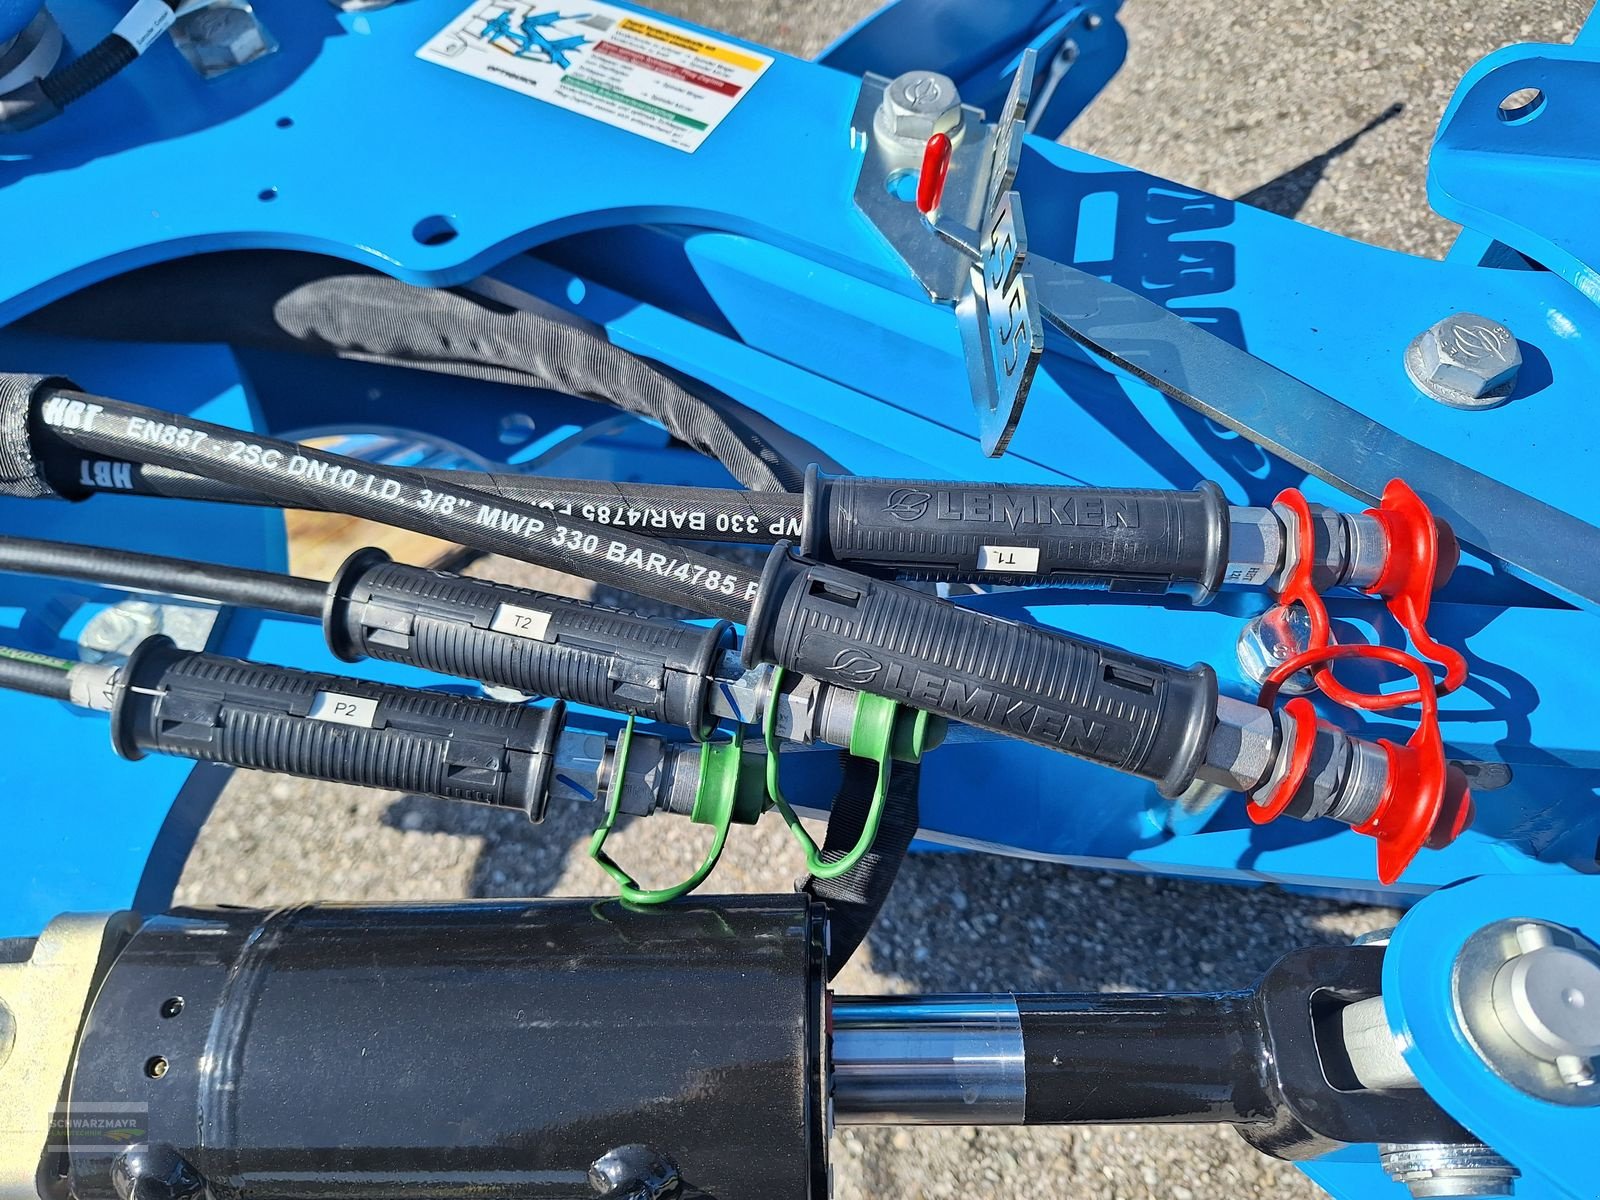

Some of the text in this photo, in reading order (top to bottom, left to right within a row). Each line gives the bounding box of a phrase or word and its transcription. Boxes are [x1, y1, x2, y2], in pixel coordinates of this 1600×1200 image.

[79, 459, 134, 489] HBT
[42, 397, 104, 432] HBT
[126, 416, 209, 450] EN857
[228, 440, 284, 469] 2SC
[288, 455, 357, 488] DN10
[365, 475, 406, 503] I.D.
[416, 488, 472, 515] 3/8"
[476, 504, 545, 538] MWP
[551, 526, 599, 554] 330
[606, 540, 738, 596] BAR/4785
[582, 504, 706, 531] BAR/4785
[716, 513, 759, 535] 330
[937, 491, 1141, 536] LEMKEN
[513, 614, 533, 630] T2
[333, 702, 358, 719] P2
[883, 661, 1107, 754] LEMKEN
